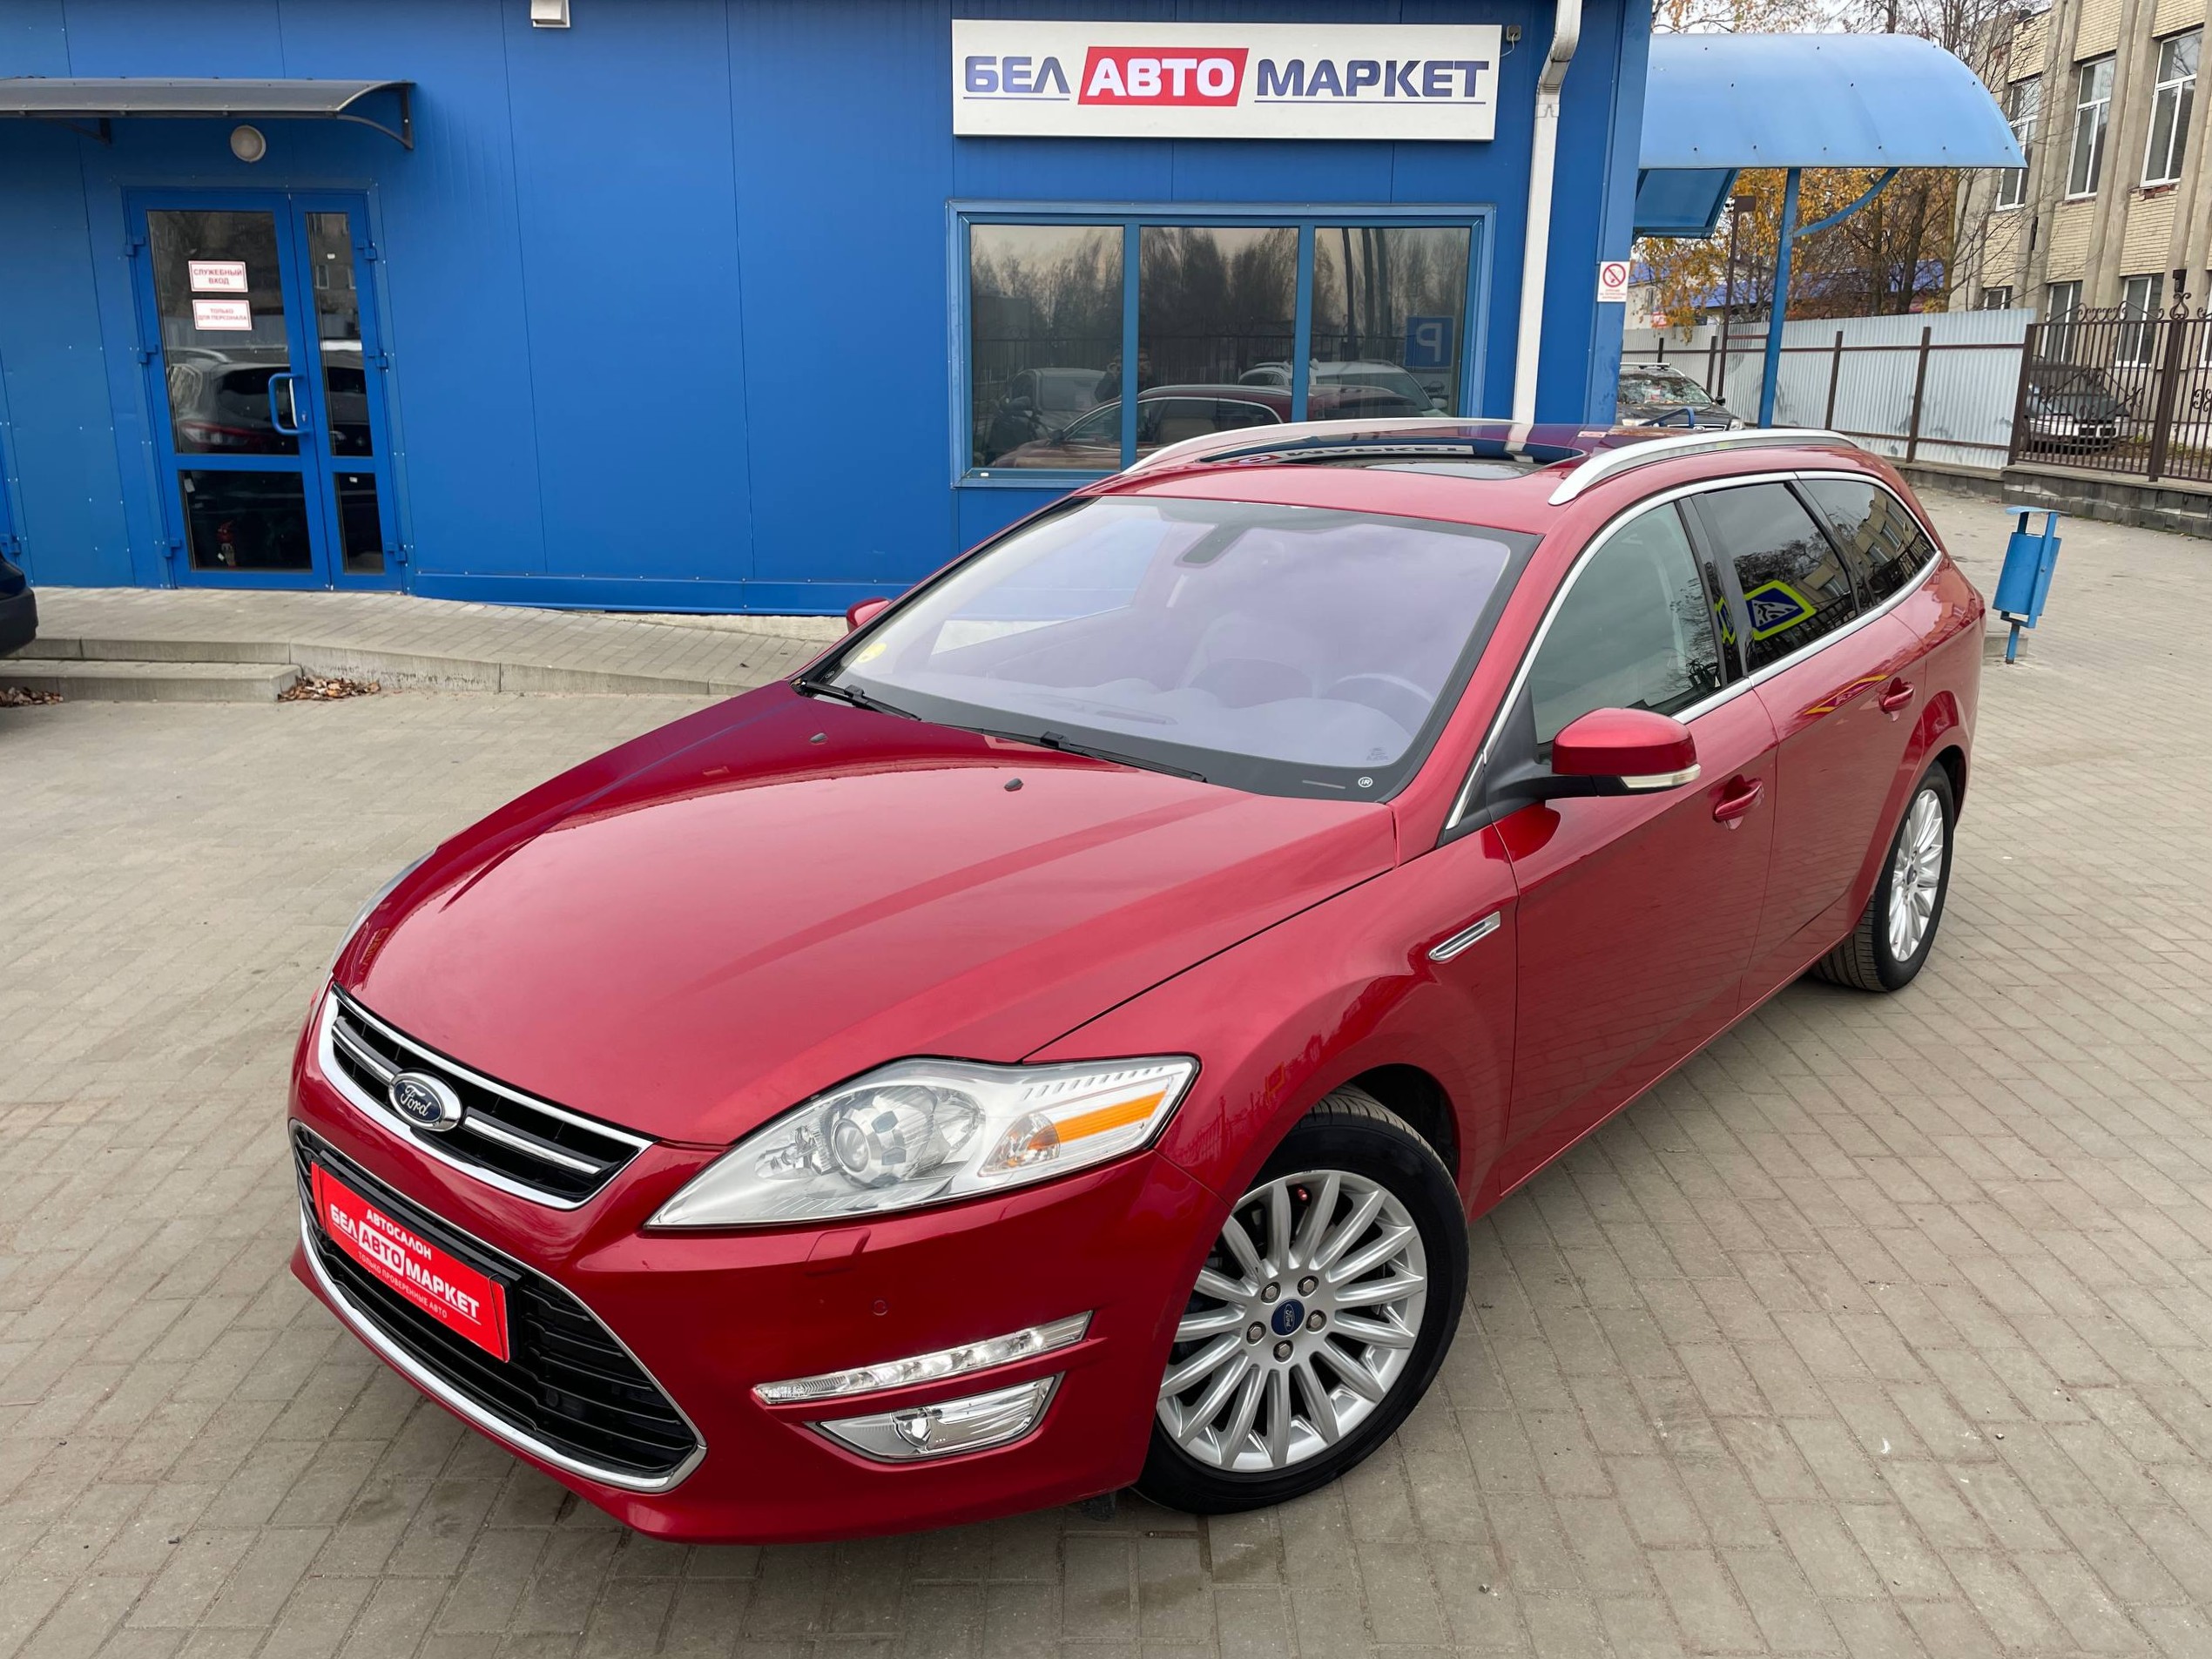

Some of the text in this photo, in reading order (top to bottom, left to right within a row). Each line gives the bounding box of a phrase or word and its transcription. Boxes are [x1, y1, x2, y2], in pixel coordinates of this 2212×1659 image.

[964, 56, 1490, 98] БЕЛ АВТО МАРКЕТ
[400, 1084, 432, 1116] Ford
[366, 1208, 432, 1260] АВТОСАЛОН
[330, 1203, 480, 1318] БЕЛ АВТО МАРКЕТ
[358, 1251, 448, 1318] ТОЛЬКО ПРОВЕРЕННЫЕ АВТО
